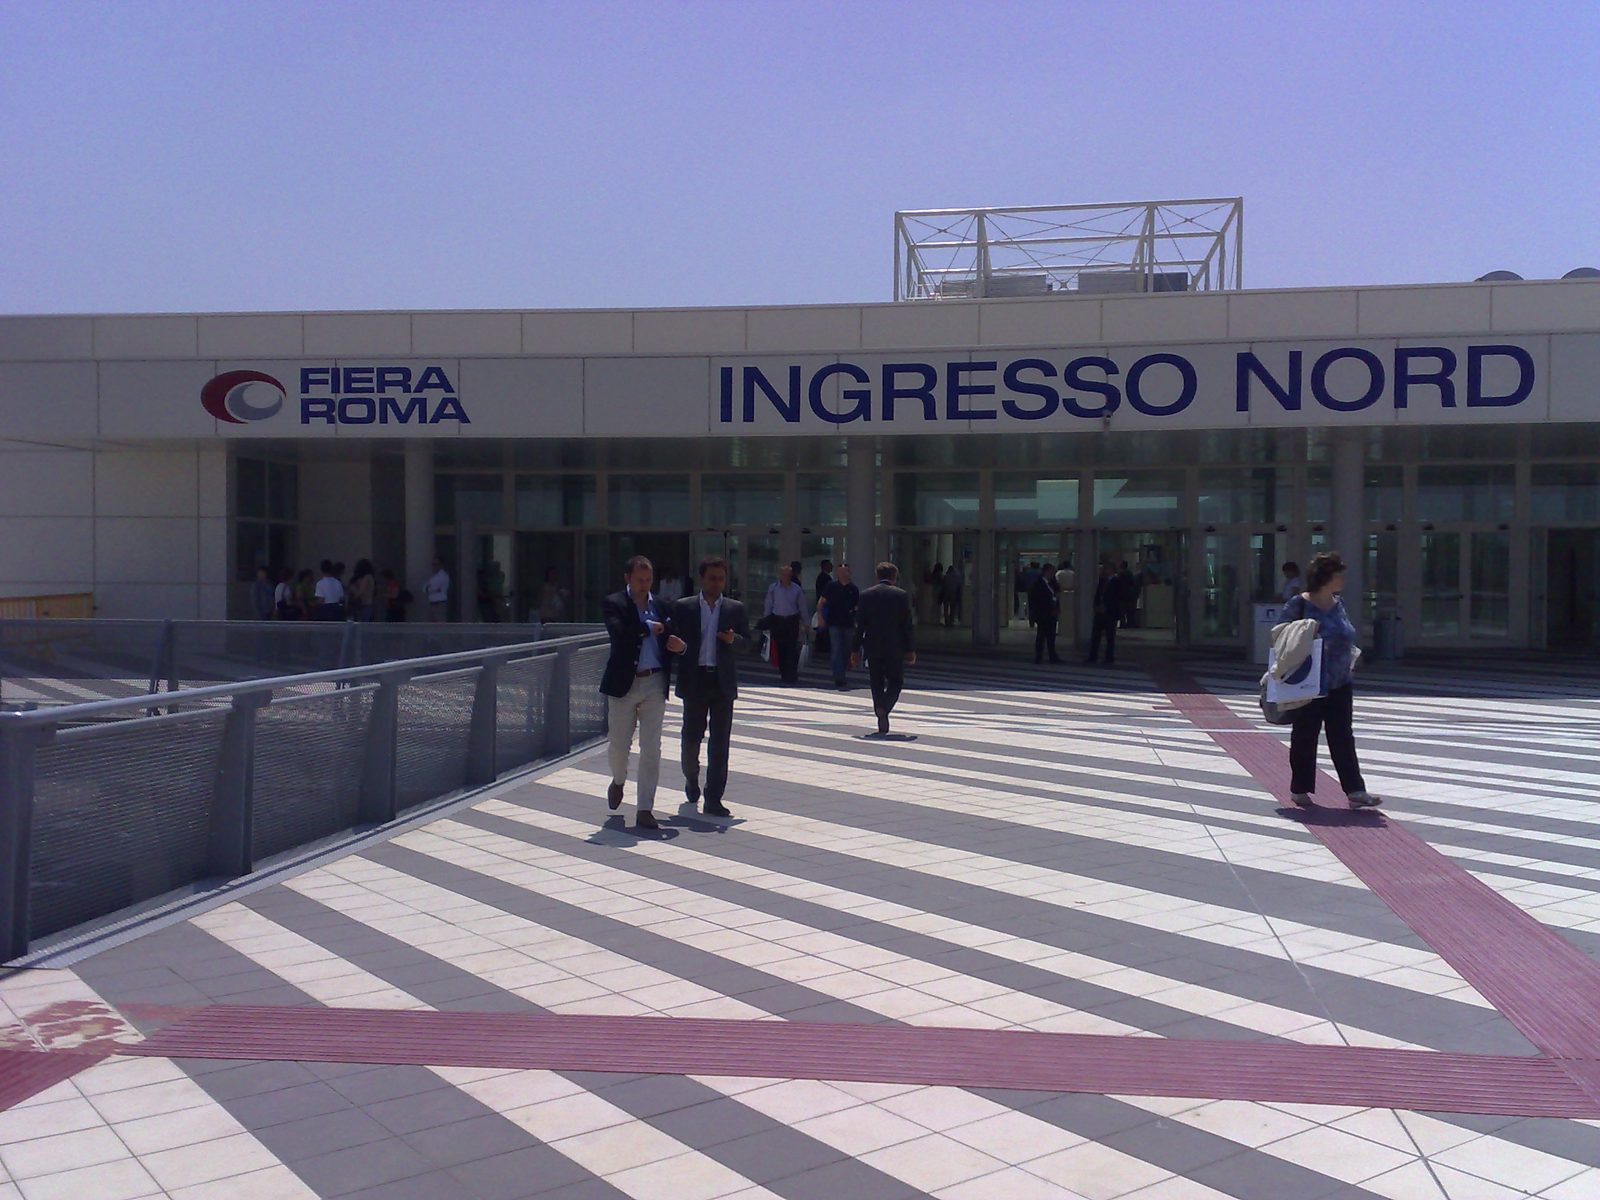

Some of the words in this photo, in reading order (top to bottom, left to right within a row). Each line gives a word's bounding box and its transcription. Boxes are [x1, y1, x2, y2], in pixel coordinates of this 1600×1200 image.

[300, 367, 455, 394] FIERA
[720, 353, 1198, 424] INGRESSO
[1236, 344, 1535, 412] NORD
[300, 397, 471, 425] ROMA
